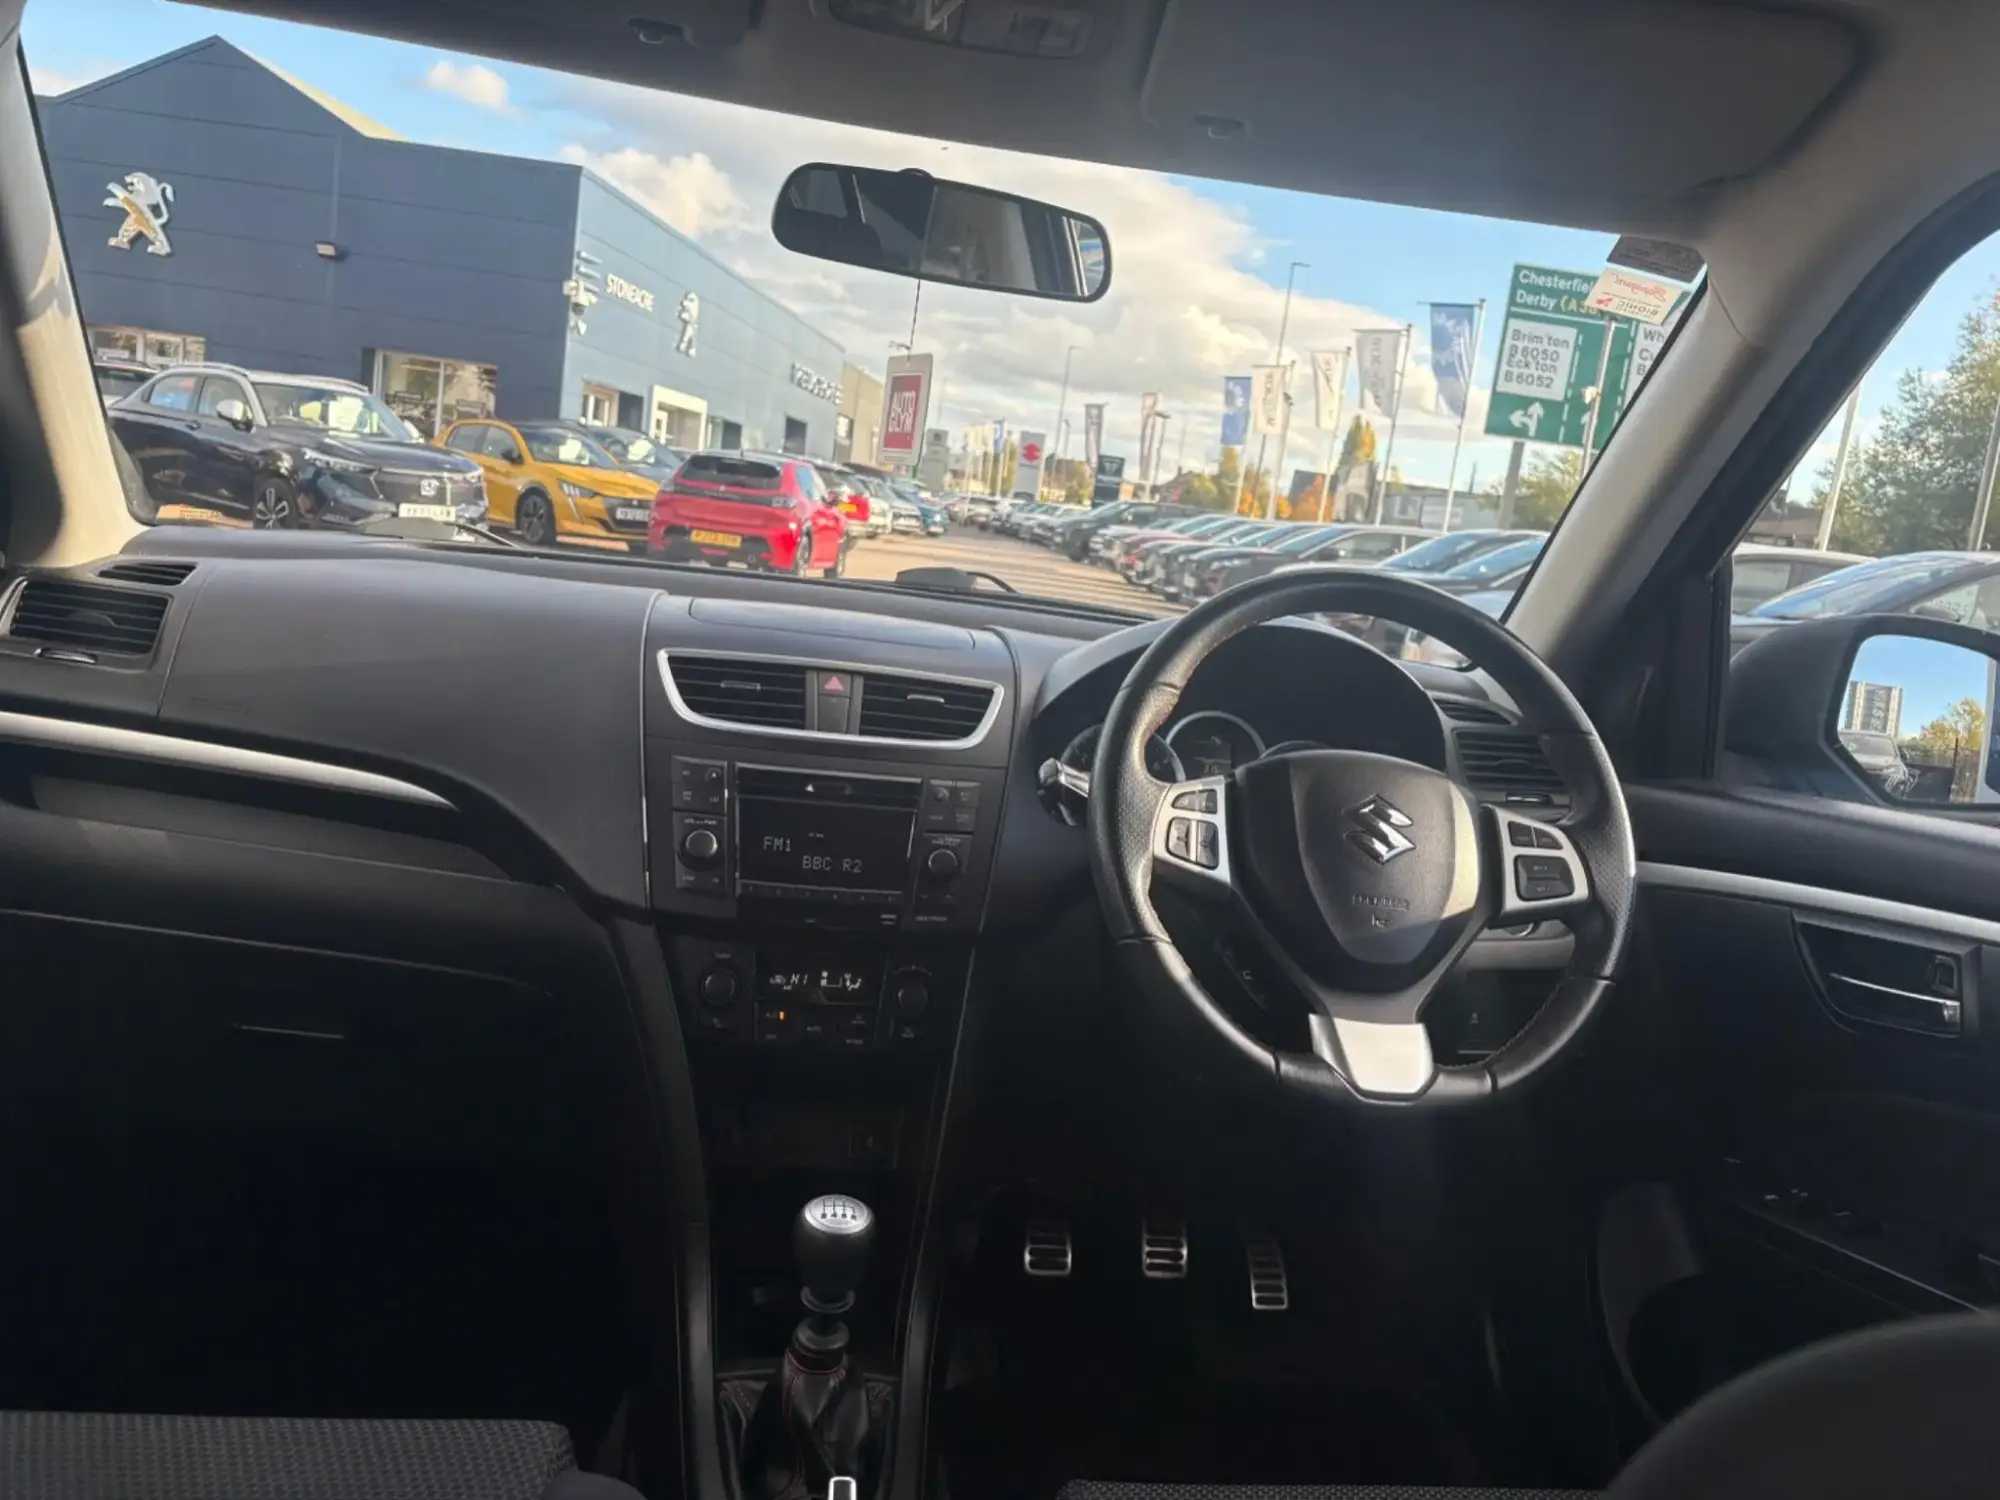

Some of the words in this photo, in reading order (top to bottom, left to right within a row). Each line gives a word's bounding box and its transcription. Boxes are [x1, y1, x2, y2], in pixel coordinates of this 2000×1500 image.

[1518, 268, 1595, 294] Chesterfiel
[1516, 290, 1557, 311] Derby
[891, 390, 917, 412] AUTO
[887, 409, 914, 434] GLYM
[763, 836, 792, 853] FM1
[802, 854, 833, 872] BBC
[842, 858, 863, 874] R2
